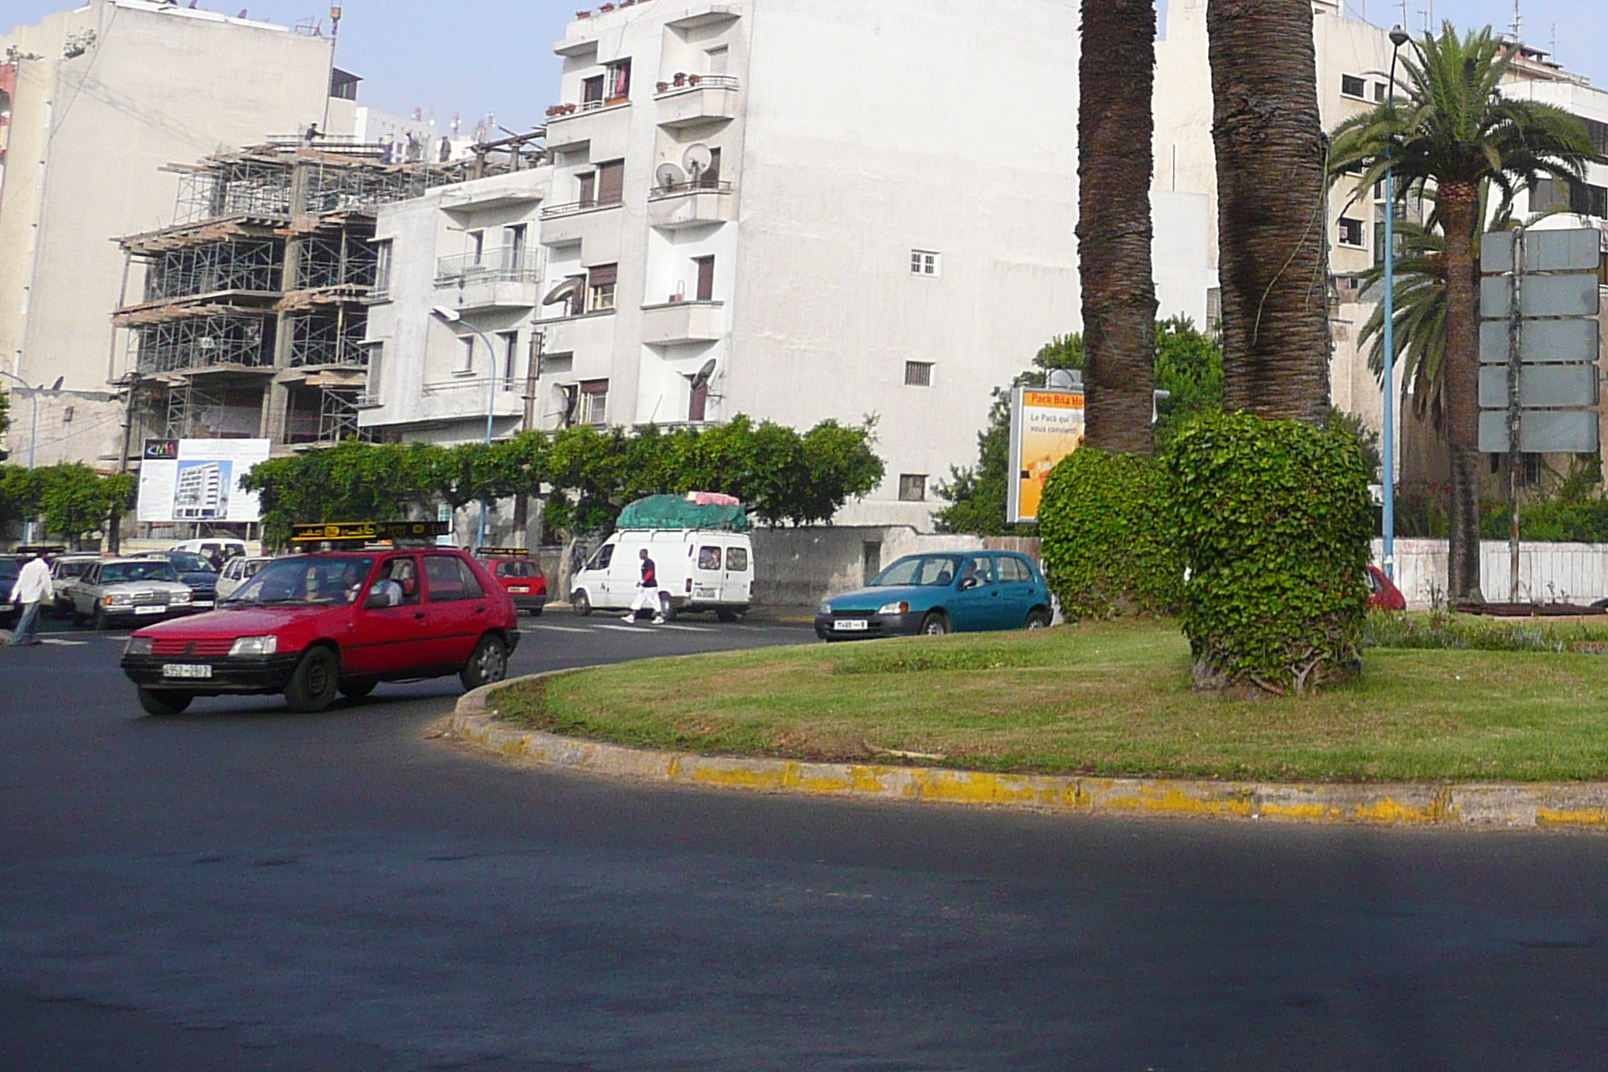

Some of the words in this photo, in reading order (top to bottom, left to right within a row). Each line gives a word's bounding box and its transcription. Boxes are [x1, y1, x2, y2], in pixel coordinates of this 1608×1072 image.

[1031, 393, 1052, 403] Pack
[1054, 394, 1071, 405] Bila
[1030, 413, 1039, 421] Le
[1041, 414, 1057, 422] Pack
[1059, 416, 1070, 424] qui
